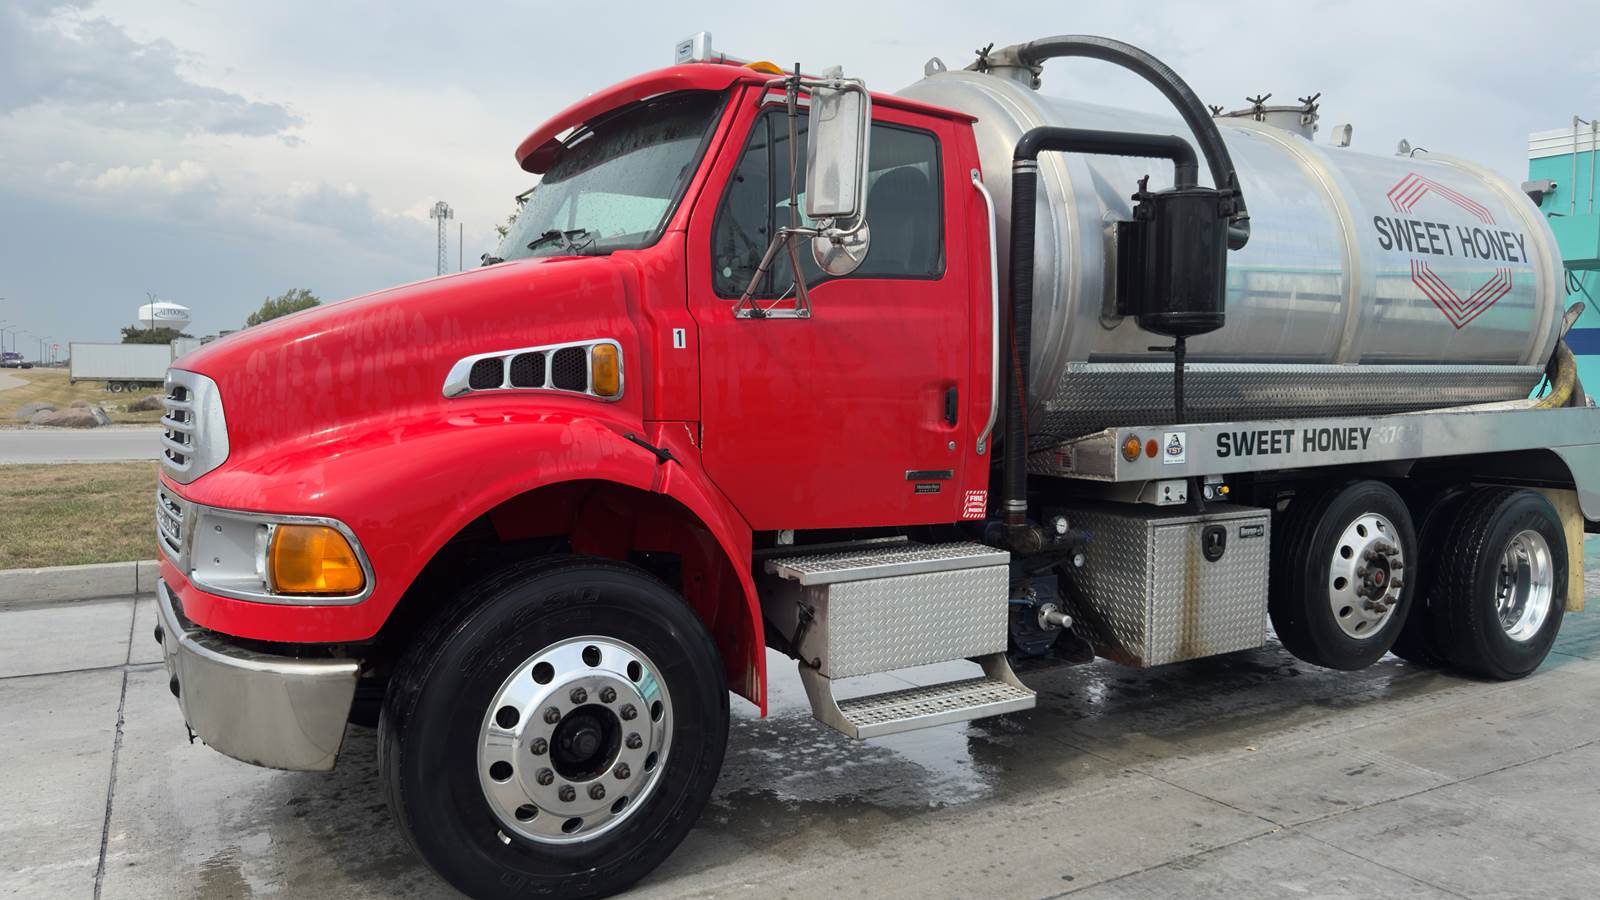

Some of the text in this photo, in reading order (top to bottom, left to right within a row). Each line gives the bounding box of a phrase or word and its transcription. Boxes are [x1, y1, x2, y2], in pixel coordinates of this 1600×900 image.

[1373, 215, 1528, 264] SWEET HONEY
[676, 329, 682, 347] 1
[1216, 429, 1295, 458] SWEET
[1302, 426, 1372, 453] HONEY
